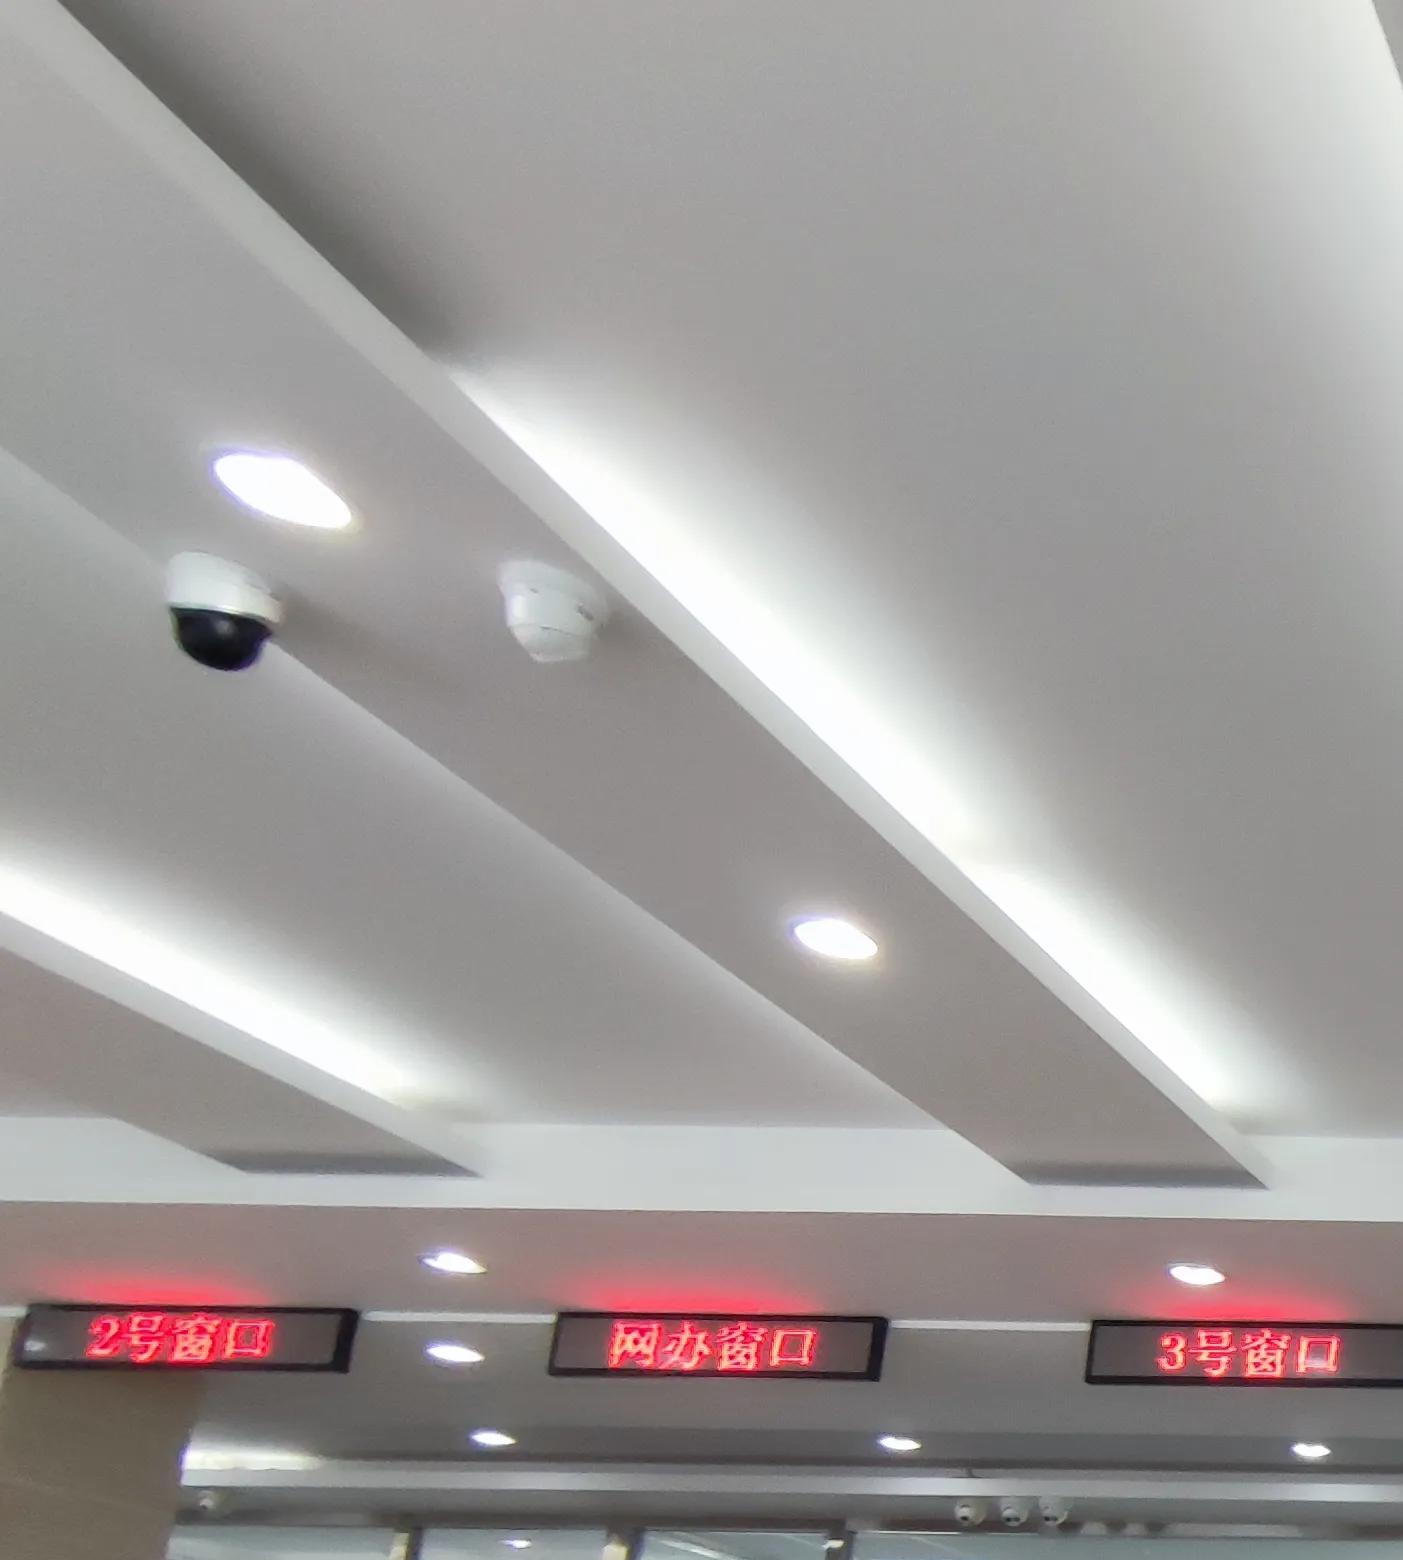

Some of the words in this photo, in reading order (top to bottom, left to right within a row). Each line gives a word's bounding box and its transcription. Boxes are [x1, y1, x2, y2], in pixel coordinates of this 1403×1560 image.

[86, 1314, 275, 1363] 2号窗口
[608, 1322, 818, 1371] 网办窗口
[1157, 1329, 1341, 1378] 3号窗口
